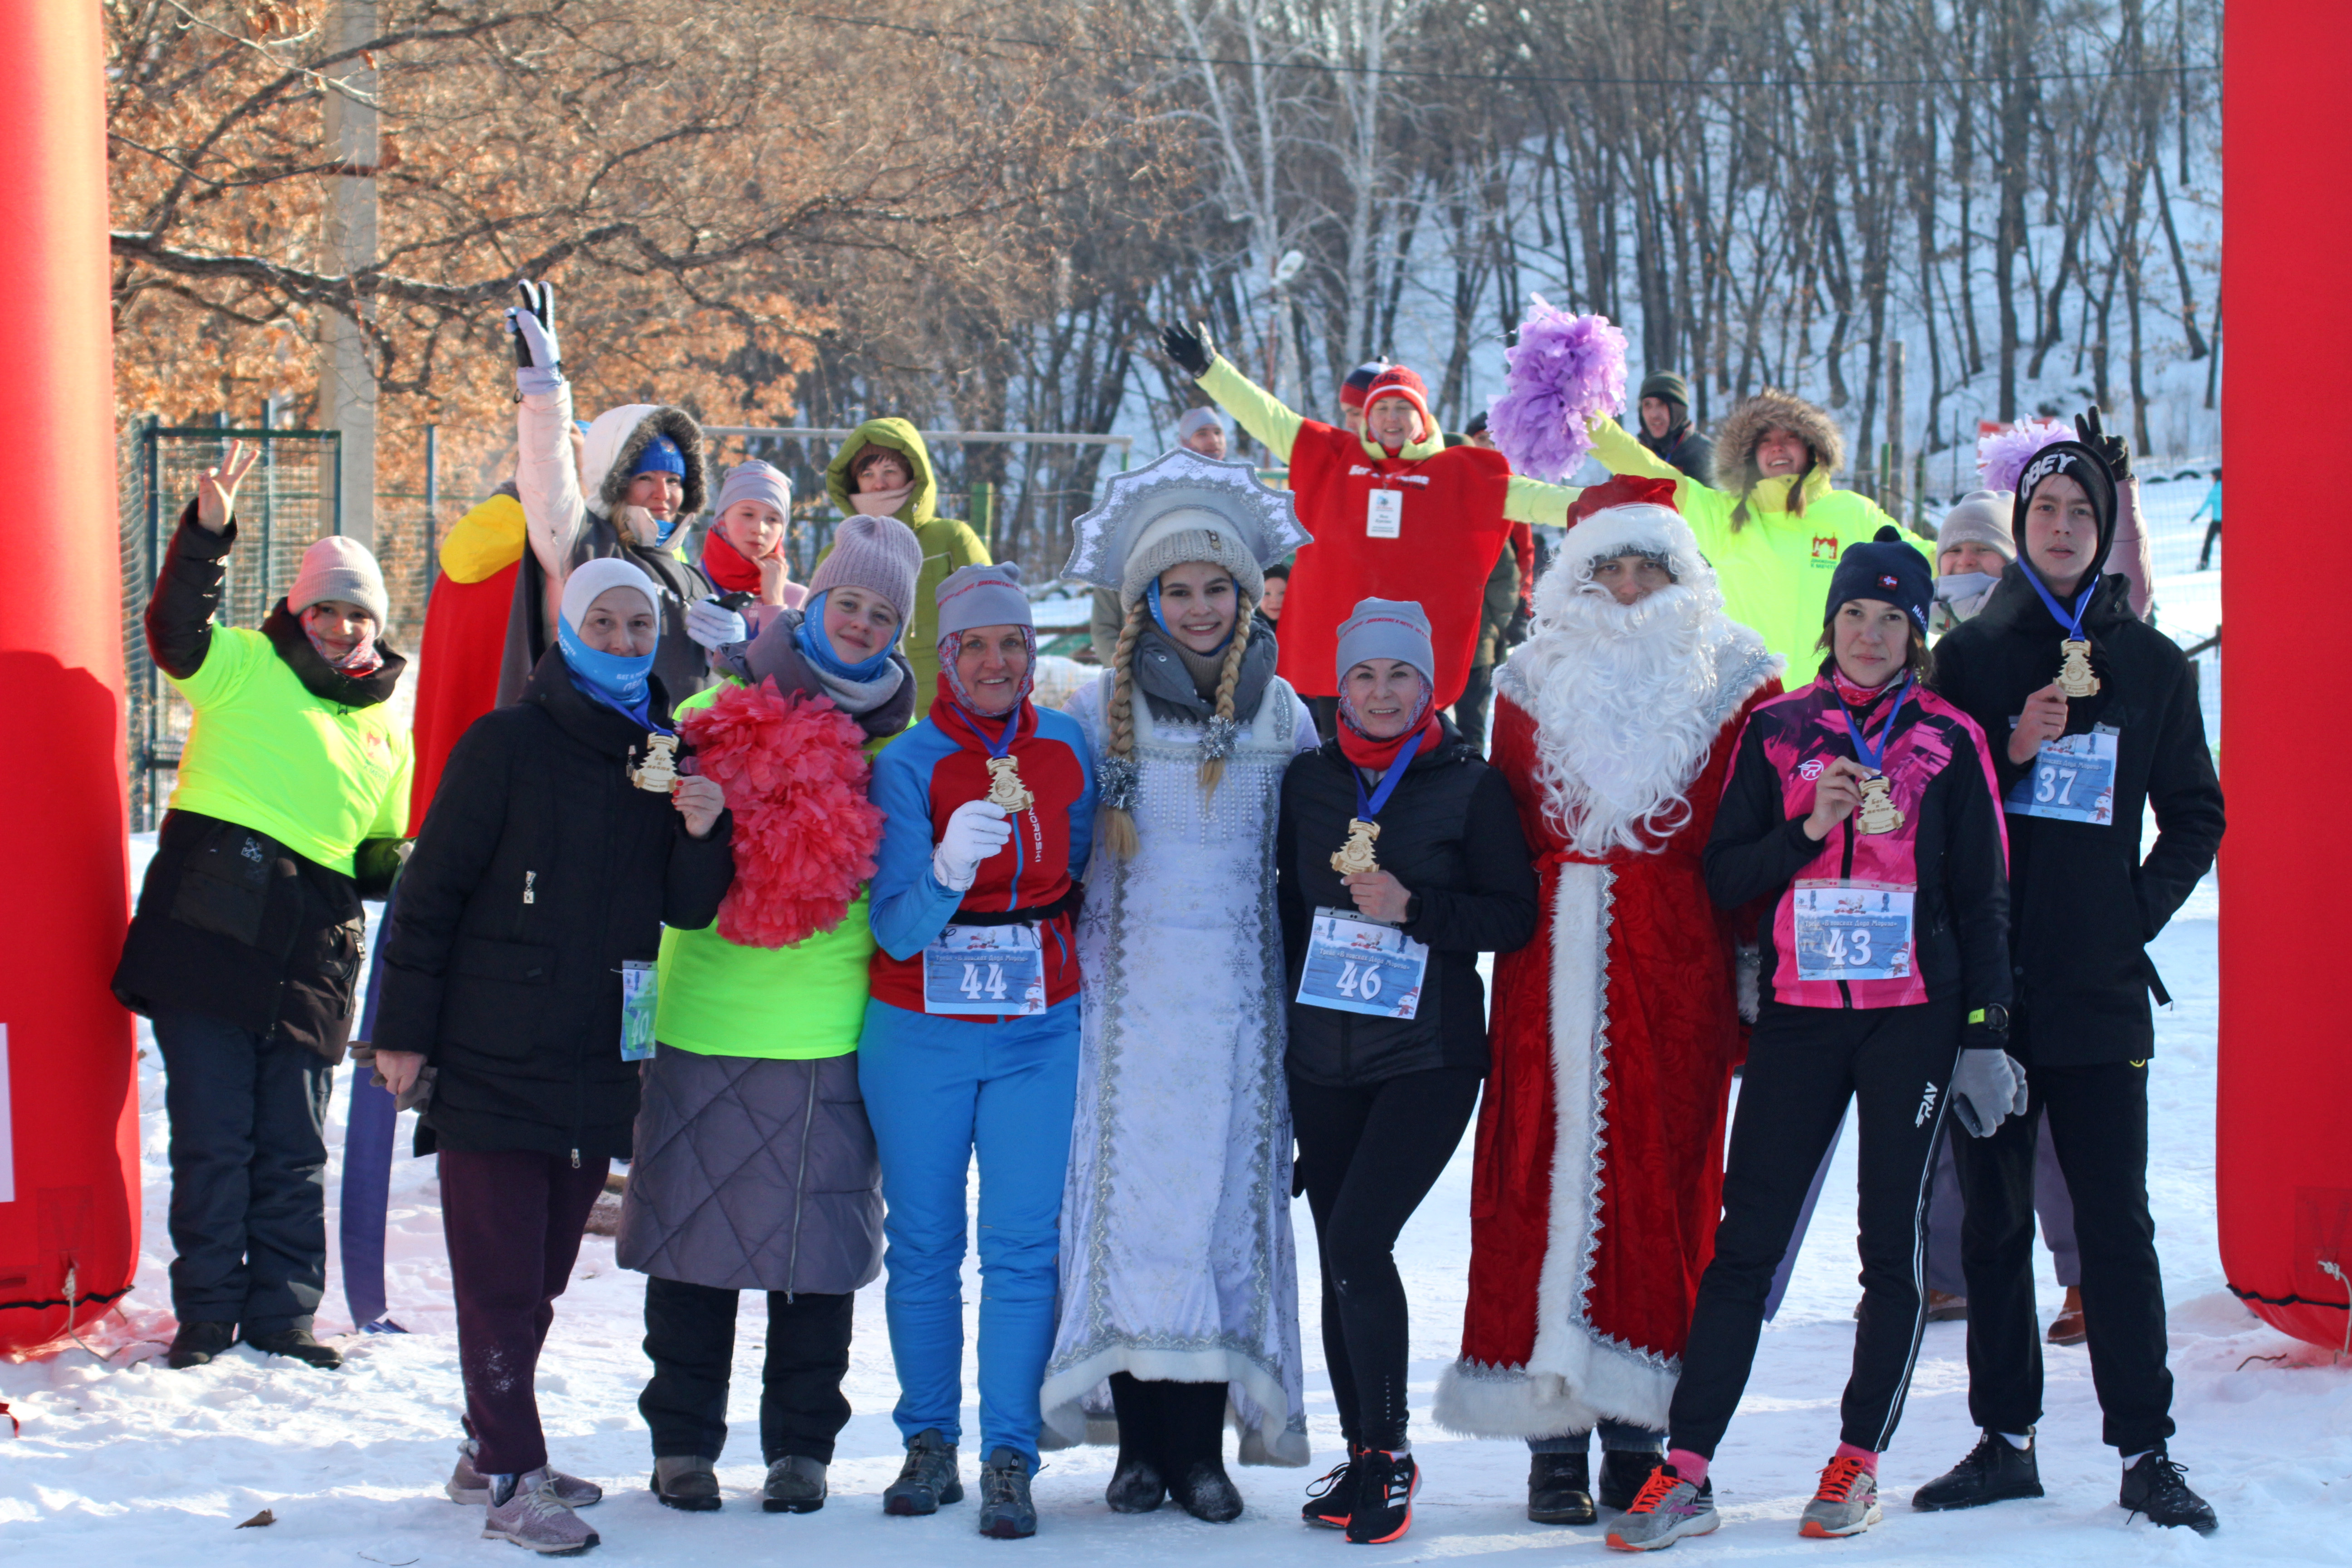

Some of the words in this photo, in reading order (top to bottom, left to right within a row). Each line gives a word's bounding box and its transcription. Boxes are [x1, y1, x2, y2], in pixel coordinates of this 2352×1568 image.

[2020, 453, 2078, 503] OBEY
[2035, 767, 2078, 806] 37
[1028, 807, 1042, 862] NORDSKI
[1346, 953, 1368, 961] поисках
[1368, 956, 1384, 965] Деда
[1827, 928, 1872, 966] 43
[960, 963, 1008, 1000] 44
[1335, 960, 1382, 1000] 46
